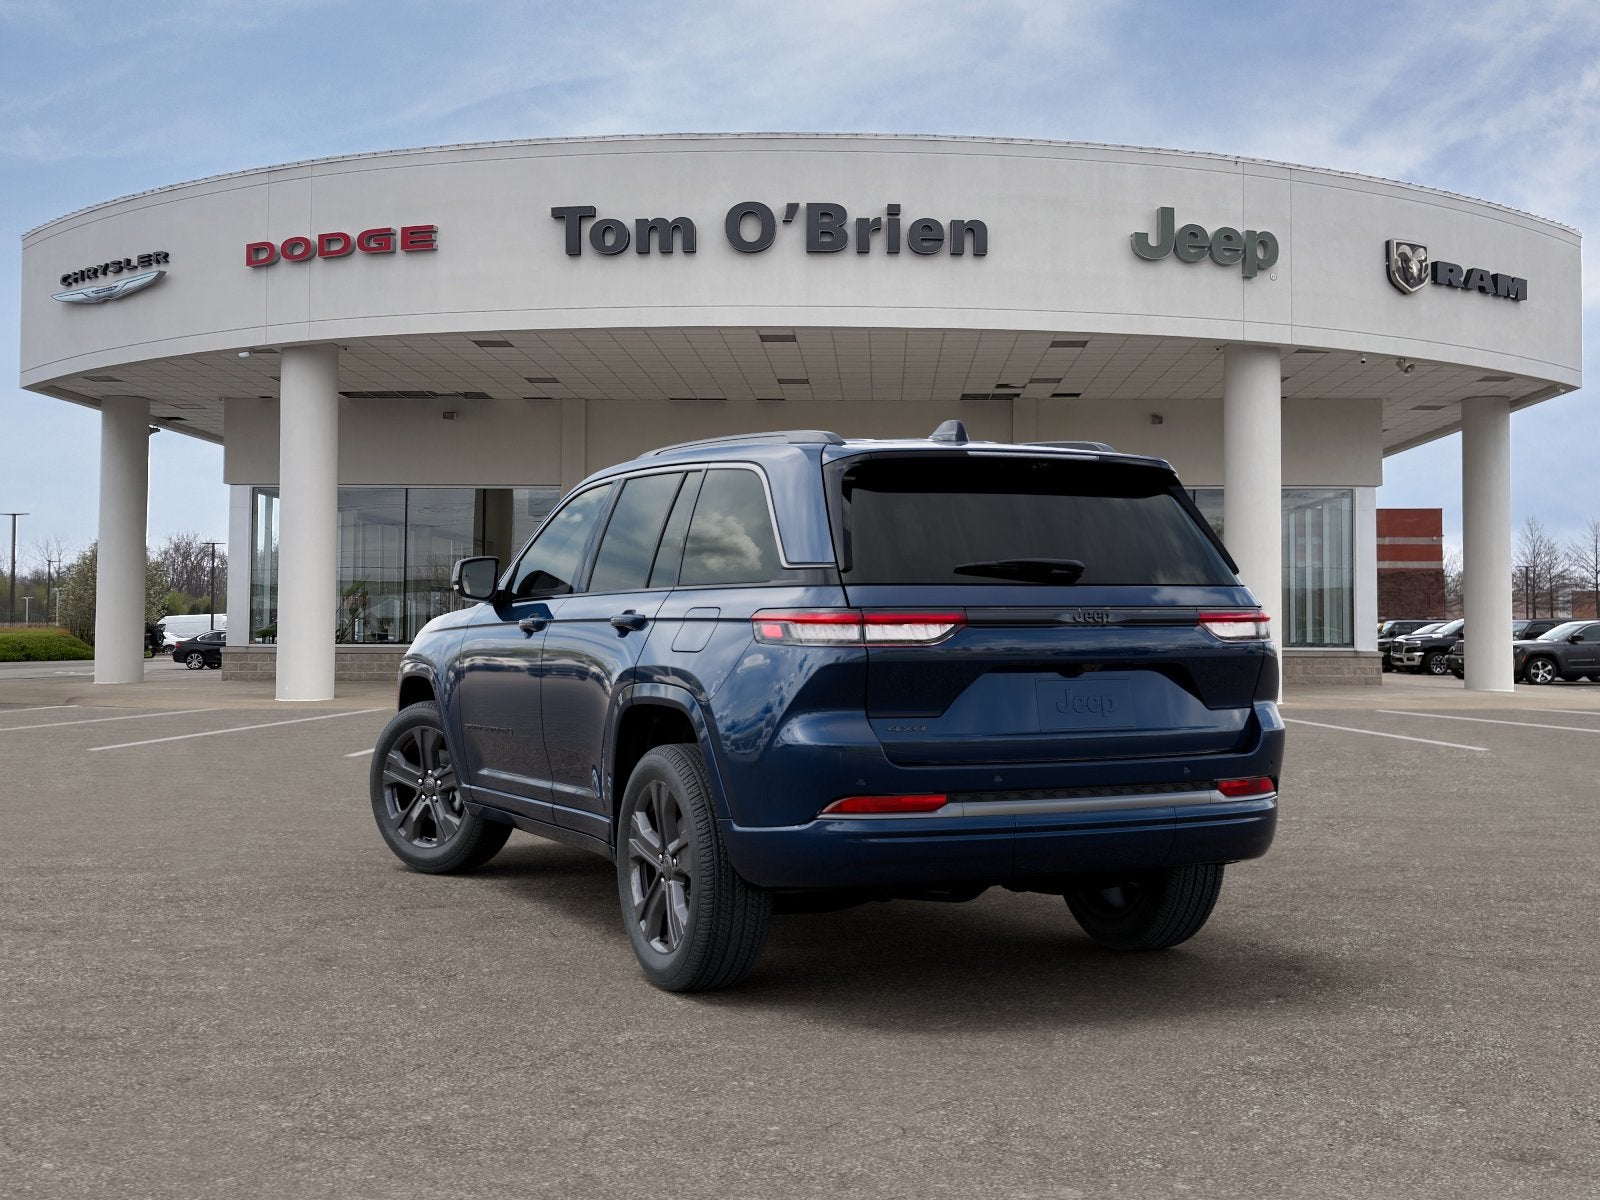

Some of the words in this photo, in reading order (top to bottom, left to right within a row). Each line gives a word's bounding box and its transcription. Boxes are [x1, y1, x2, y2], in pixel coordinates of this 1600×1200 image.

[245, 224, 439, 269] DODGE
[551, 205, 697, 256] Tom
[1131, 206, 1279, 278] Jeep
[60, 250, 170, 287] CHRYSLER
[1430, 260, 1528, 302] RAM
[1072, 607, 1111, 625] Jeep
[1055, 688, 1117, 718] Jeep
